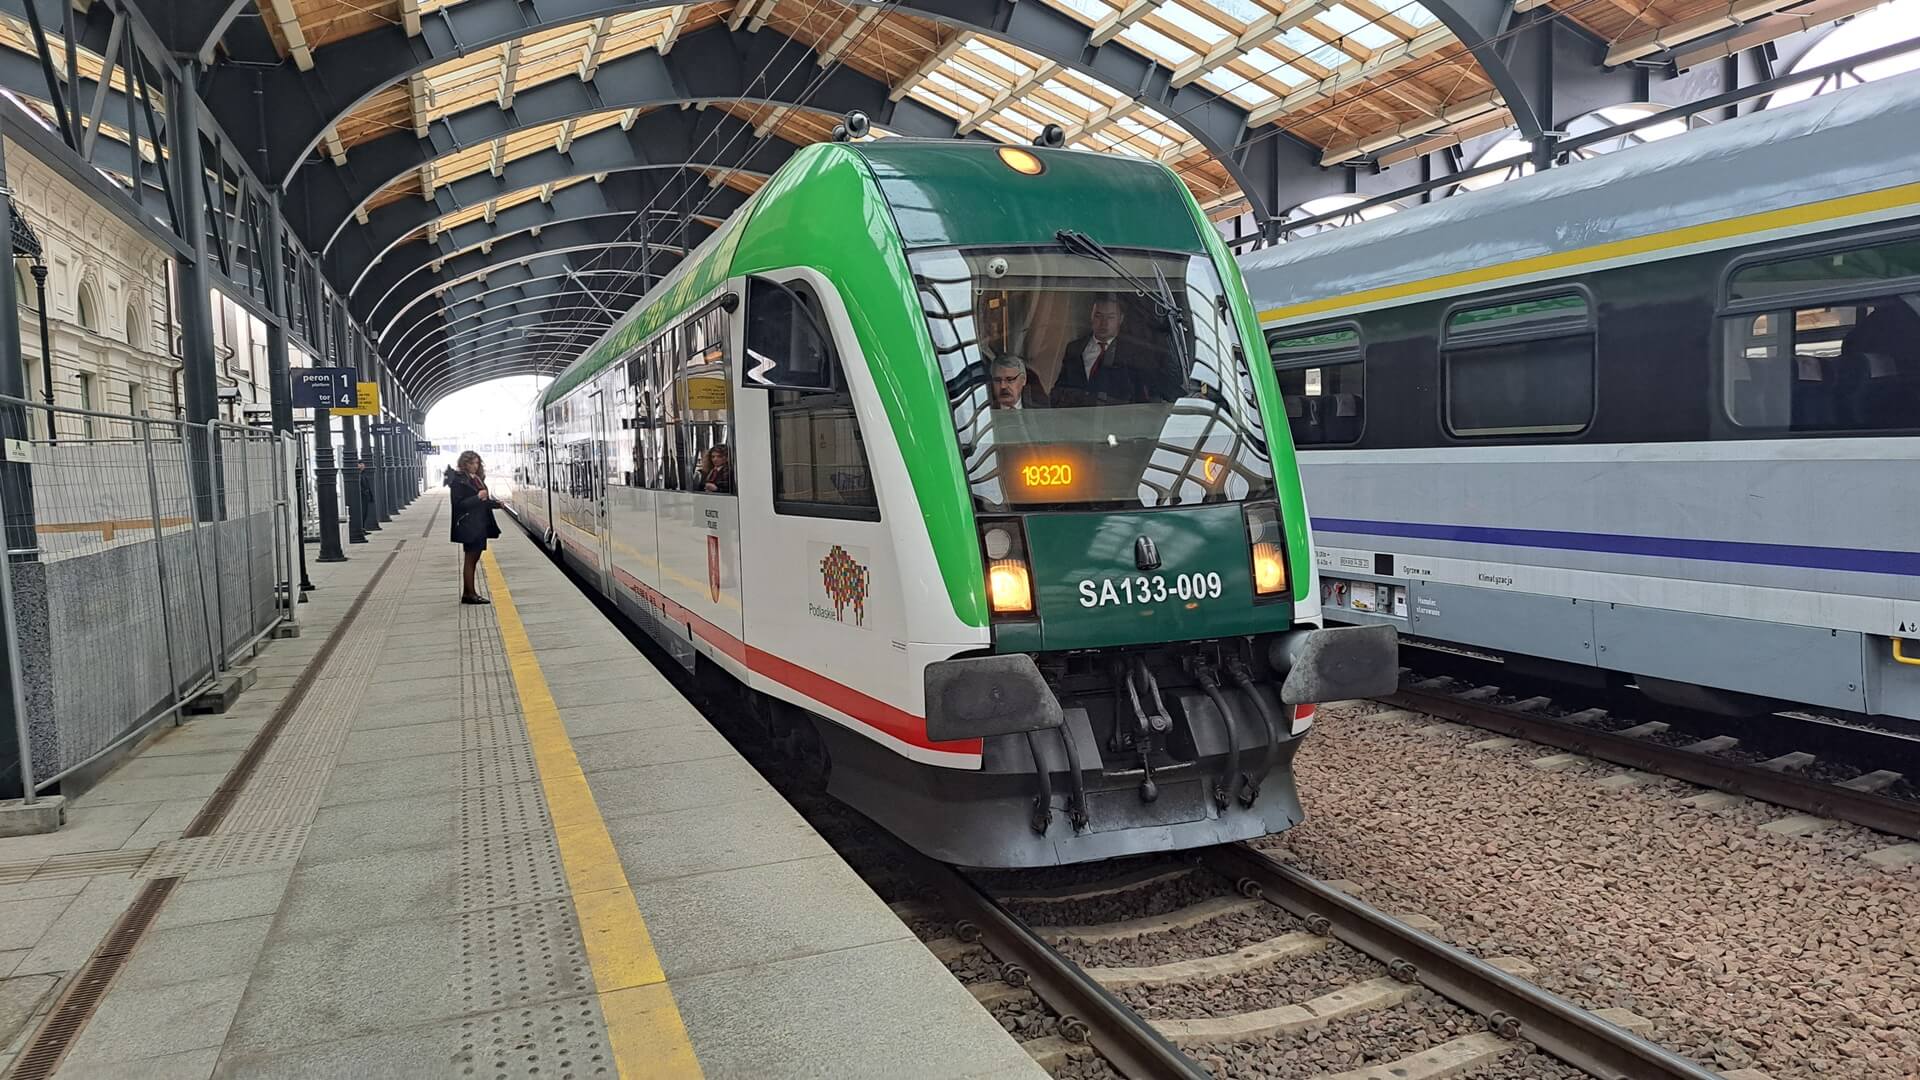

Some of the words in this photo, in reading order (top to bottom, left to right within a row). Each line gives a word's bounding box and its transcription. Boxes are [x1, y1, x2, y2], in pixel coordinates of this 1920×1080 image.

[341, 374, 348, 388] 1
[341, 394, 350, 404] 4
[1022, 464, 1072, 486] 19320
[1478, 573, 1513, 586] Klimatyzacja
[1079, 572, 1222, 608] SA133-009
[809, 602, 836, 620] Podlaskie
